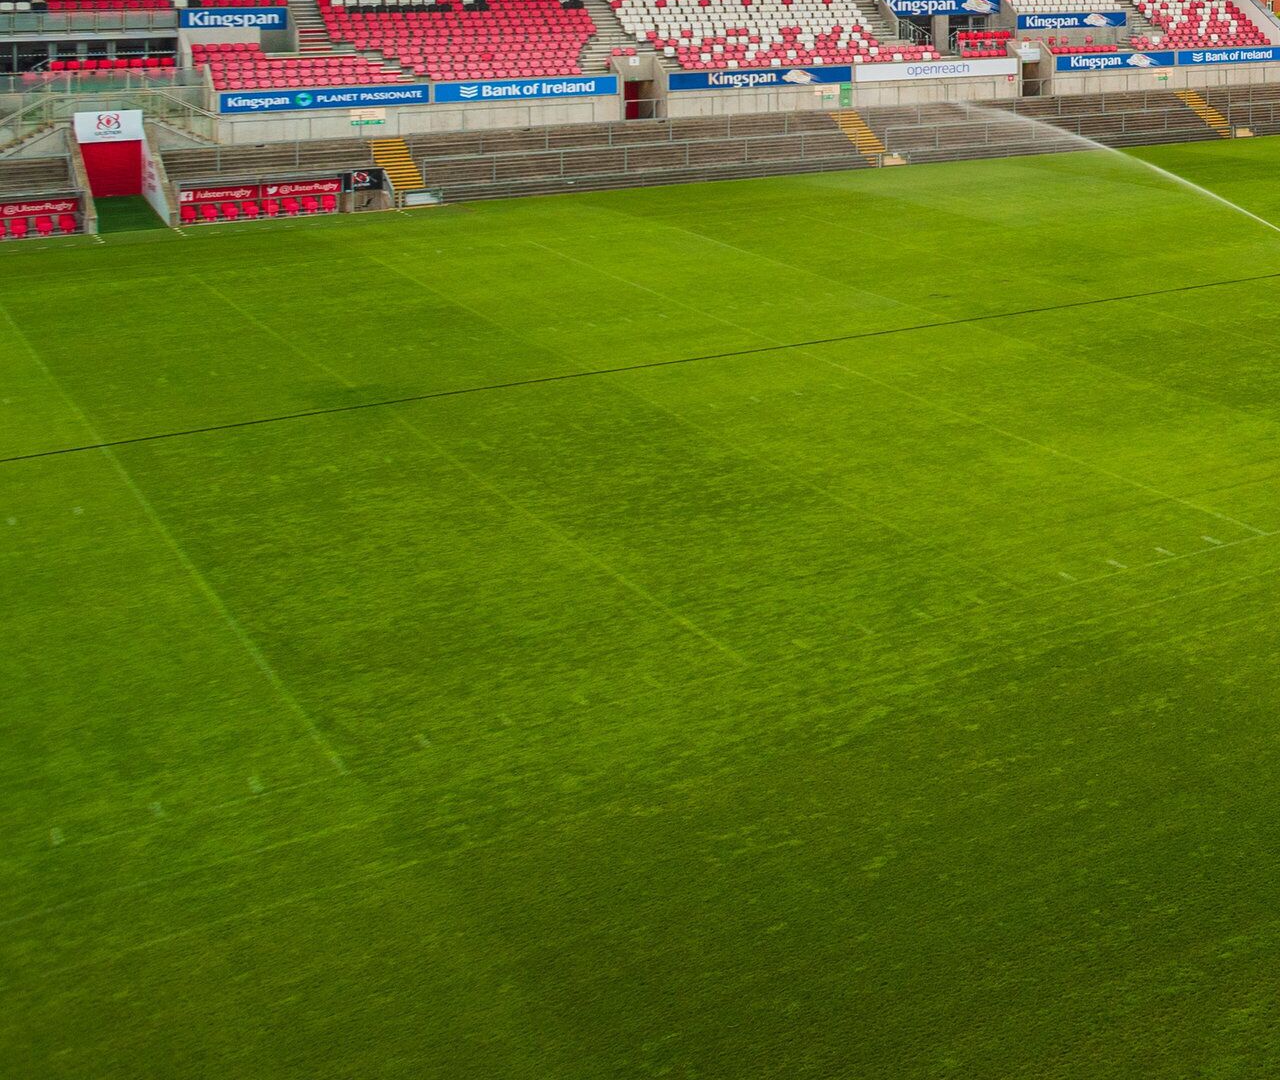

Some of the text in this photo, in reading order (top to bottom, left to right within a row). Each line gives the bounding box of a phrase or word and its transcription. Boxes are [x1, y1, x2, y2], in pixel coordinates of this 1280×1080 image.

[188, 11, 280, 27] Kingspan
[1025, 15, 1079, 29] Kingspan
[1070, 55, 1122, 70] Kingspan
[1205, 50, 1273, 62] Bank of Ireland
[906, 63, 970, 77] openreach
[707, 70, 778, 88] Kingspan
[482, 81, 596, 97] Bank of Ireland
[227, 90, 423, 108] Kingspan PLANET PASSIONATE
[196, 188, 252, 200] /ulsterrugby
[279, 182, 339, 195] @UlsterRugby
[3, 202, 74, 216] @UlsterRugby
